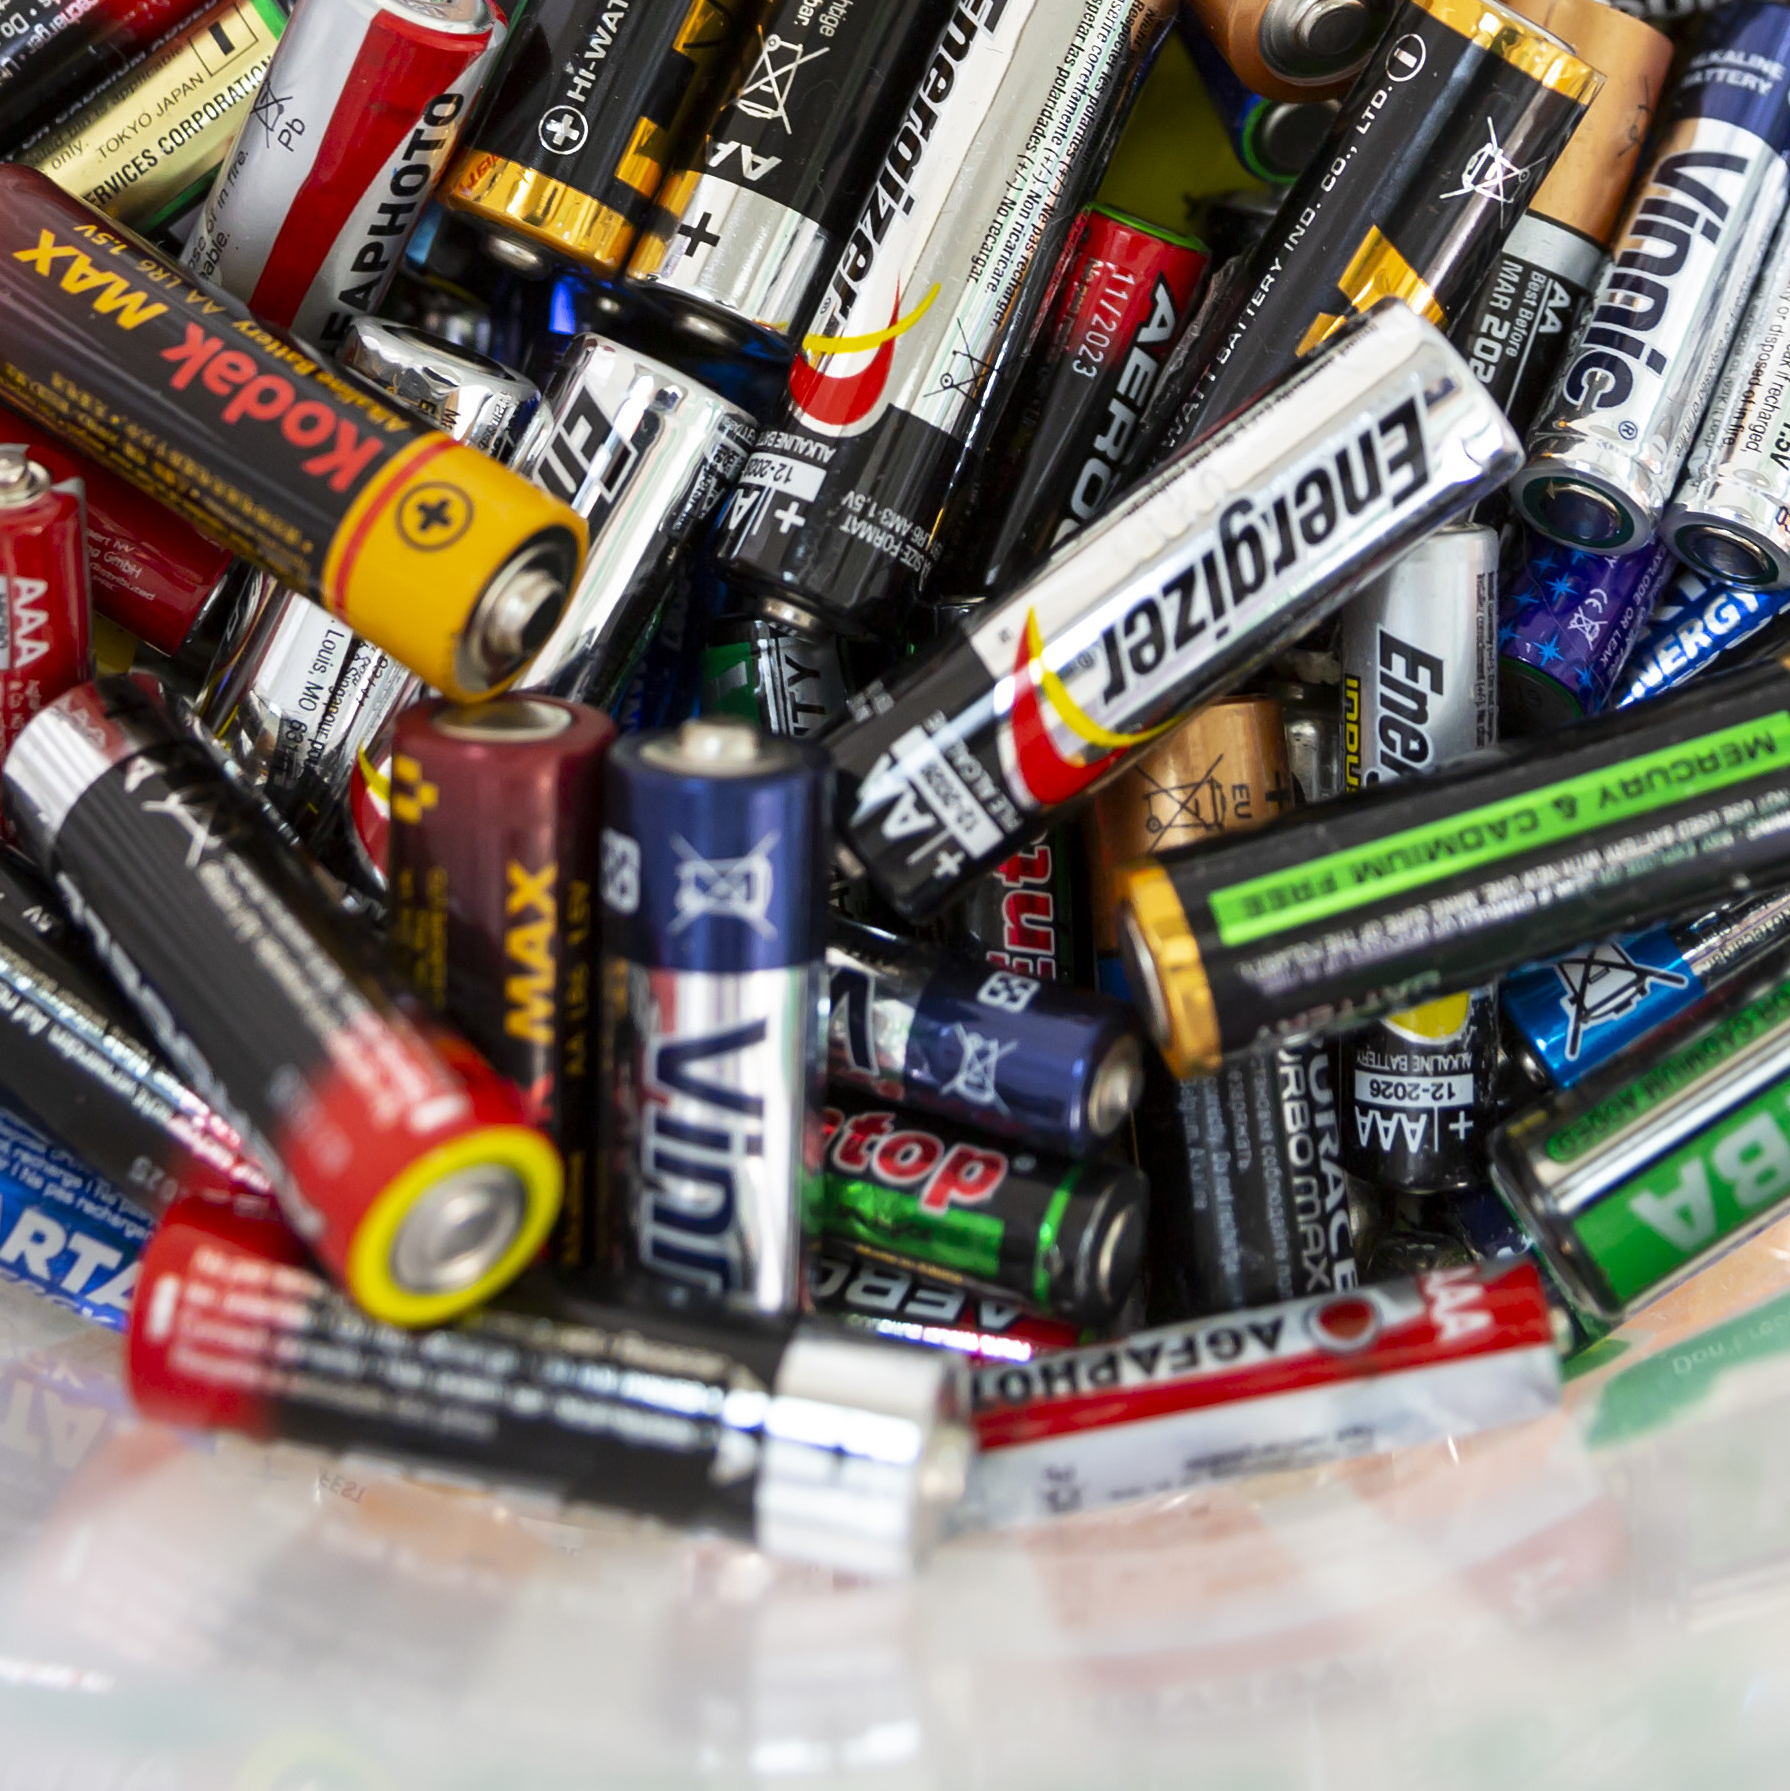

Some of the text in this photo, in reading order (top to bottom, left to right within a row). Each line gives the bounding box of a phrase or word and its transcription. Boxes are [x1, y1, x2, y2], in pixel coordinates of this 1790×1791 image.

[1062, 42, 1084, 68] las
[81, 54, 284, 211] ERVICES CORPORATION
[94, 71, 207, 160] TOKYO JAPAN
[278, 117, 305, 151] Pb
[1018, 65, 1076, 155] polaridades
[994, 194, 1017, 220] No
[961, 217, 1007, 287] recargar.
[1566, 149, 1748, 411] Vinnic
[71, 214, 412, 440] Alkaline Battery AA LR6 1.5V
[1070, 271, 1137, 379] 11/2023
[1458, 258, 1527, 387] MAR 202
[1500, 270, 1548, 358] Best Before
[1532, 281, 1578, 340] AA
[12, 226, 382, 492] Kodak MAX
[1070, 273, 1176, 512] AERO
[773, 419, 837, 474] ALKALINE
[1740, 378, 1785, 458] recharged,
[1103, 400, 1431, 706] Energizer
[10, 575, 49, 667] AAA
[1615, 576, 1765, 703] NERGY
[296, 627, 345, 713] Louis, MO
[1229, 783, 1253, 818] EU
[1548, 791, 1582, 824] &
[1592, 726, 1778, 815] MERCURY
[1346, 798, 1542, 895] CADMIUM
[1237, 866, 1339, 923] FREE
[506, 859, 558, 1047] MAX
[1369, 1079, 1456, 1101] 12-2026
[1637, 1012, 1758, 1102] CADMIUM
[1355, 1106, 1427, 1153] AAA
[814, 1259, 1022, 1331] AERO
[973, 1317, 1284, 1404] AGFAPHO
